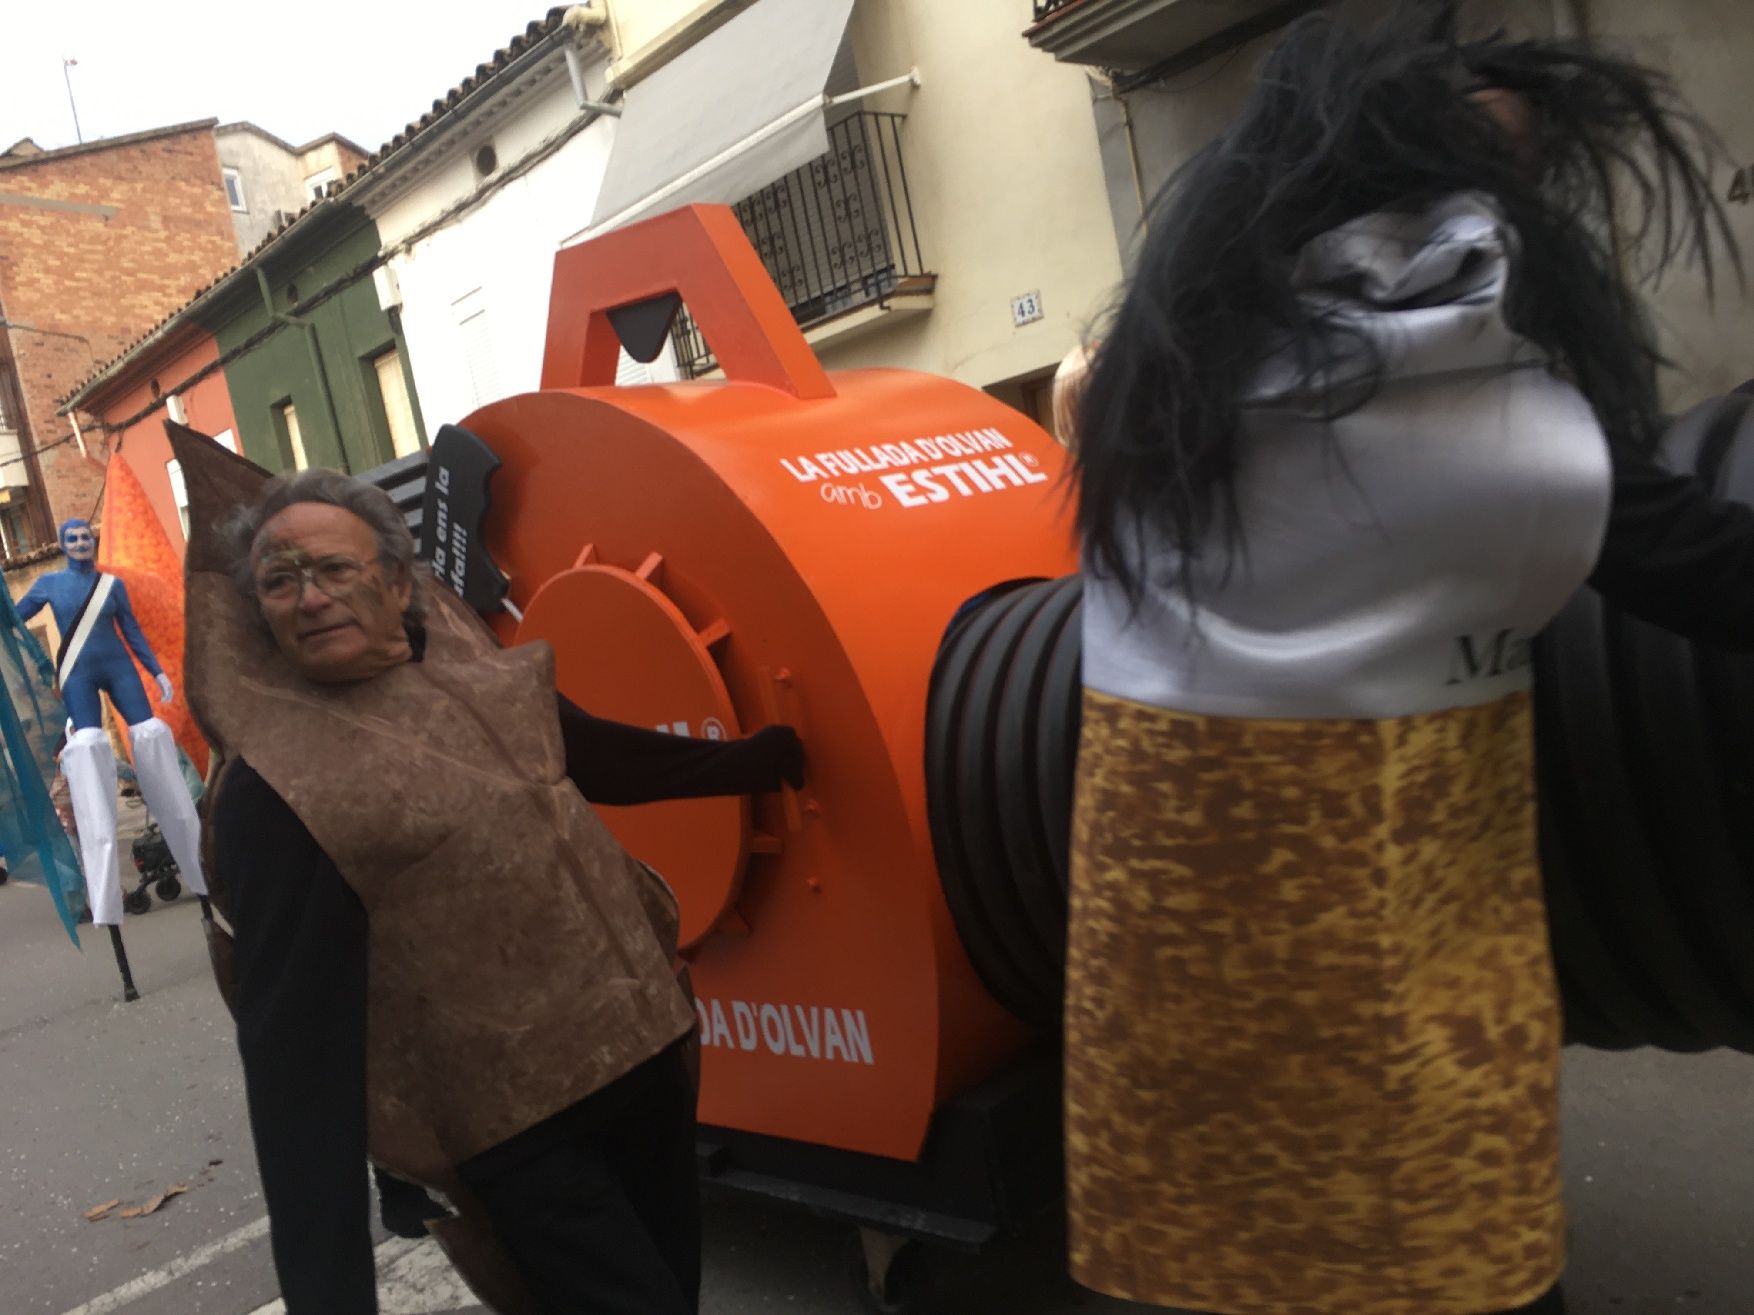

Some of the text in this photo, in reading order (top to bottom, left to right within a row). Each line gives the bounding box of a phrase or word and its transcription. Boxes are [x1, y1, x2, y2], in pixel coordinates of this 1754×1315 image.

[1017, 298, 1035, 318] 43
[780, 427, 1013, 482] LA FULLADA D'OLVAN
[434, 466, 450, 496] la
[820, 482, 883, 510] amb
[436, 499, 449, 543] ens
[731, 999, 875, 1065] D'OLVAN
